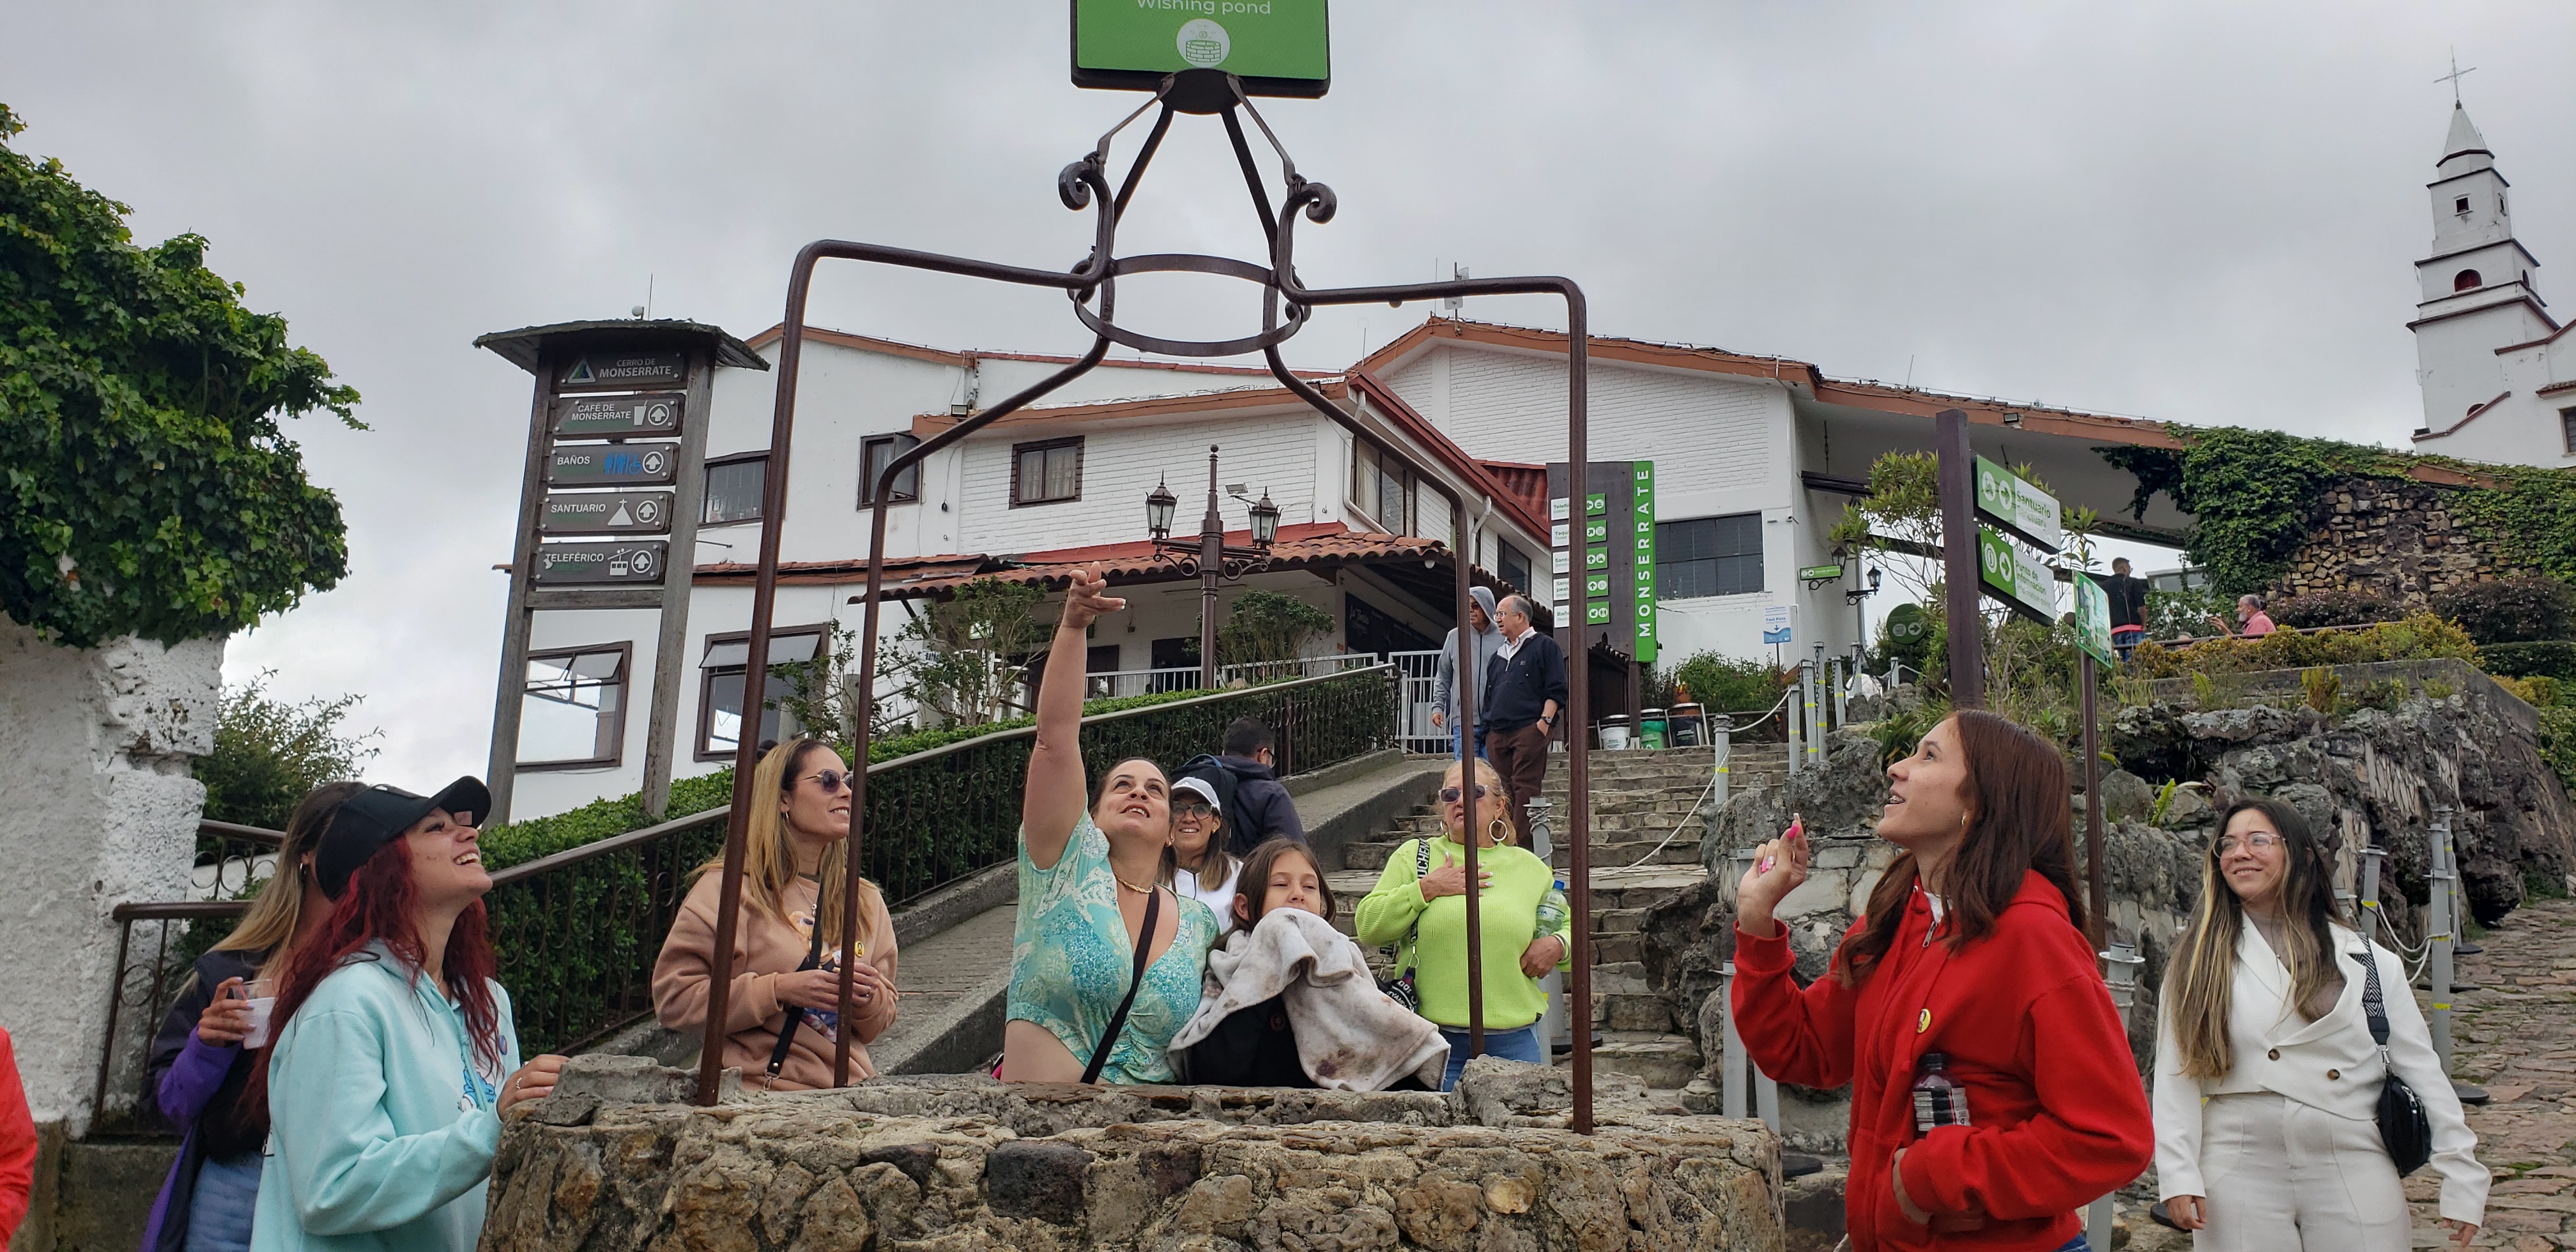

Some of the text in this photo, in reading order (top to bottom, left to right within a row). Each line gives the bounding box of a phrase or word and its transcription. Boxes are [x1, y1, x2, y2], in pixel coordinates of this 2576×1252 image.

[1137, 0, 1271, 15] Wishing pond
[617, 359, 643, 367] CERRO
[599, 366, 671, 378] MONSERRATE
[578, 403, 601, 413] CAFÉ
[572, 411, 632, 421] MONSERRATE
[557, 455, 590, 465] BAÑOS
[551, 504, 606, 513] SANTUARIO
[2016, 490, 2051, 519] Santuario
[546, 552, 604, 563] TELEFÉRICO
[1637, 470, 1651, 637] MONSERRATE
